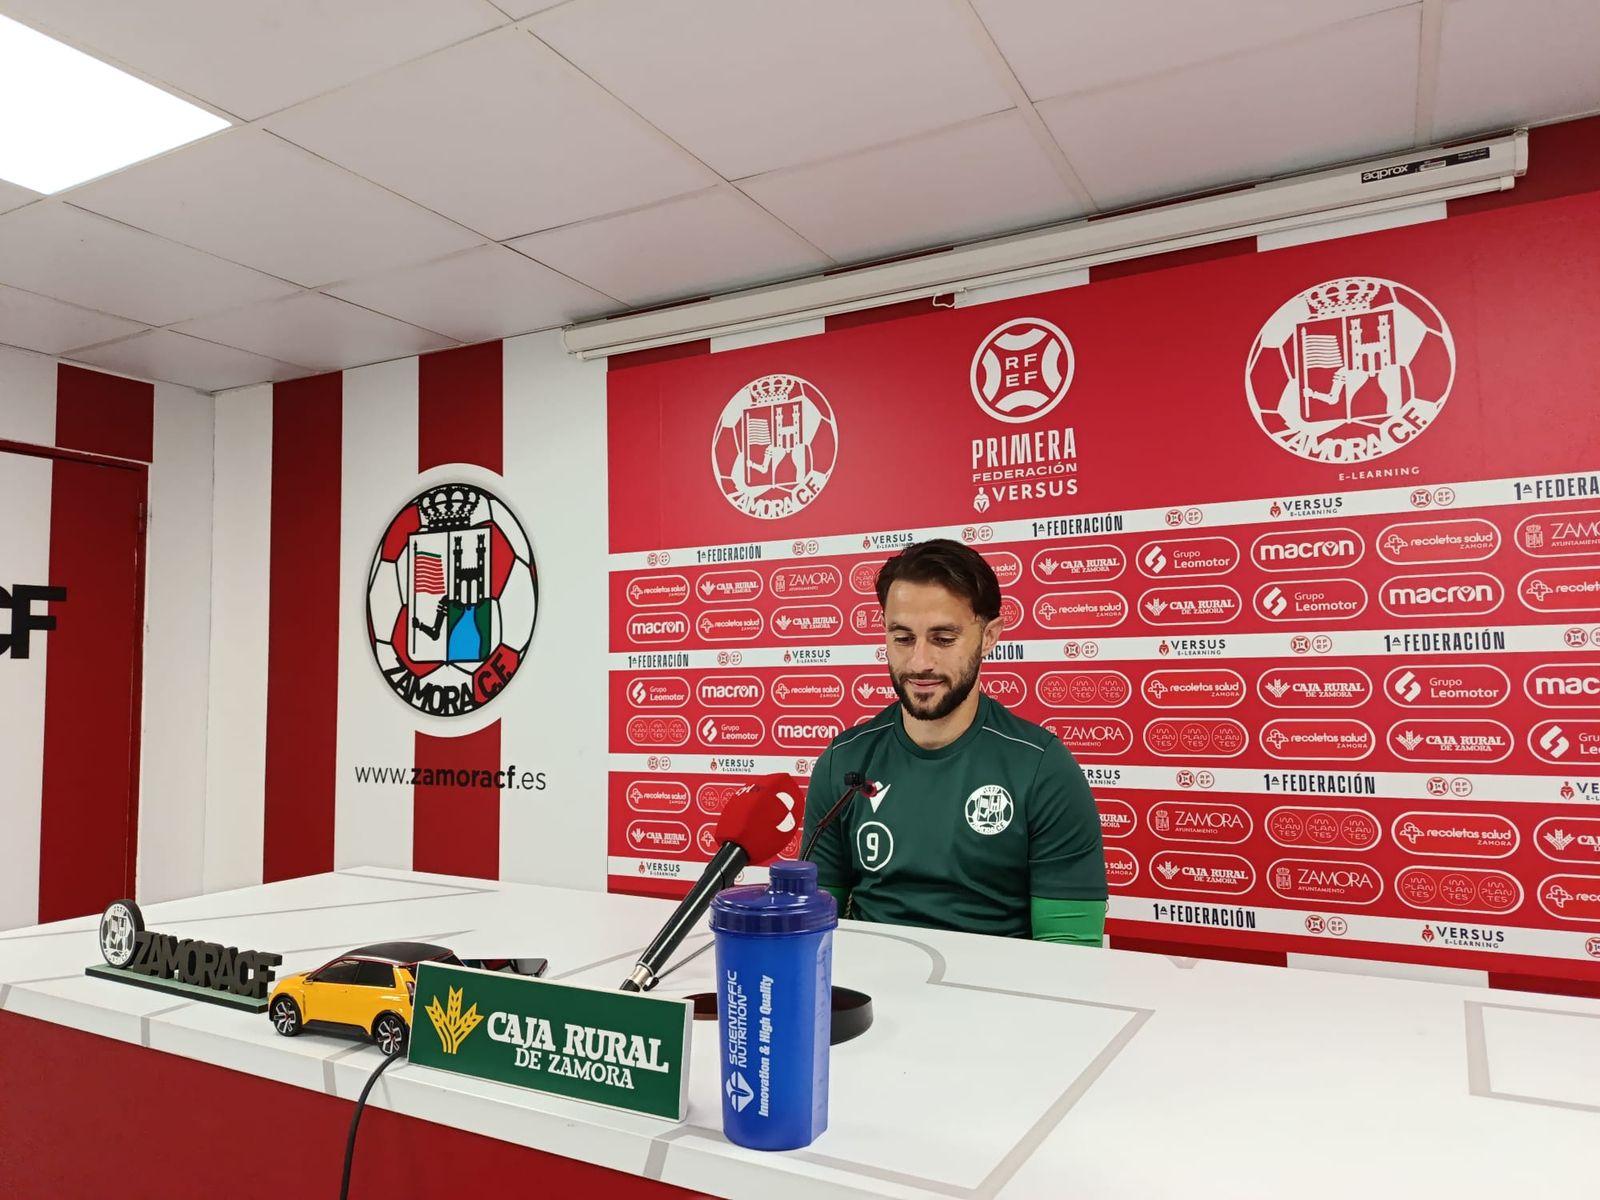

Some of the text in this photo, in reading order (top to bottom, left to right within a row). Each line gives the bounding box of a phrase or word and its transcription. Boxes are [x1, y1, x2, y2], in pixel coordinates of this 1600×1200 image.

[1363, 165, 1408, 180] aqprox
[1271, 407, 1427, 461] ZAMORA C.F.
[972, 427, 1076, 469] PRIMERA
[973, 462, 1077, 483] FEDERACIÓN
[1339, 466, 1420, 481] E-LEARNING
[992, 479, 1078, 501] VERSUS
[728, 490, 793, 517] ZAMORA
[1283, 497, 1342, 510] VERSUS
[1047, 515, 1123, 536] FEDERACIÓN
[872, 533, 913, 544] VERSUS
[1411, 532, 1492, 545] recoletas salud
[707, 546, 761, 562] FEDERACIÓN
[1173, 550, 1200, 559] Grupo
[1261, 540, 1354, 560] macron
[996, 563, 1016, 571] salud
[1061, 559, 1119, 569] CAJA RURAL
[1174, 558, 1230, 568] Leomotor
[789, 573, 835, 586] ZAMORA
[1295, 592, 1325, 601] Grupo
[1390, 585, 1492, 605] macron
[1059, 602, 1121, 613] recoletas salud
[1170, 600, 1234, 610] CAJA RURAL
[1296, 601, 1357, 611] Leomotor
[632, 621, 684, 635] macron
[1171, 640, 1225, 650] VERSUS
[1405, 631, 1505, 651] FEDERACIÓN
[793, 650, 830, 658] VERSUS
[638, 654, 689, 668] FEDERACIÓN
[384, 652, 511, 715] ZAMORA C.F.
[1170, 682, 1239, 692] recoletas salud
[1293, 683, 1364, 691] CAJA RURAL
[1429, 677, 1462, 687] Grupo
[702, 685, 758, 698] macron
[822, 685, 840, 693] salud
[1431, 687, 1499, 698] Leomotor
[721, 724, 739, 732] Grupo
[779, 725, 839, 738] macron
[1063, 726, 1124, 739] ZAMORA
[721, 732, 758, 740] Leomotor
[1291, 733, 1367, 743] recoletas salud
[1464, 737, 1505, 746] RURAL
[719, 759, 754, 768] VERSUS
[355, 765, 546, 790] www.zamoracf.es
[1283, 773, 1375, 794] FEDERACIÓN
[1176, 811, 1244, 829] ZAMORA
[1427, 829, 1511, 839] recoletas salud
[867, 833, 879, 861] 9
[646, 862, 680, 872] VERSUS
[1110, 861, 1132, 870] salud
[1182, 867, 1248, 879] CAJA RURAL
[1298, 869, 1373, 889] ZAMORA
[1171, 905, 1255, 928] FEDERACIÓN
[1437, 926, 1504, 942] VERSUS
[133, 931, 282, 998] ZAMORACF
[729, 970, 737, 1065] SCIENTIFFIC
[487, 1011, 669, 1073] CAJA RURAL
[758, 975, 773, 1116] Innovation & High Quality
[514, 1048, 634, 1089] DE ZAMORA
